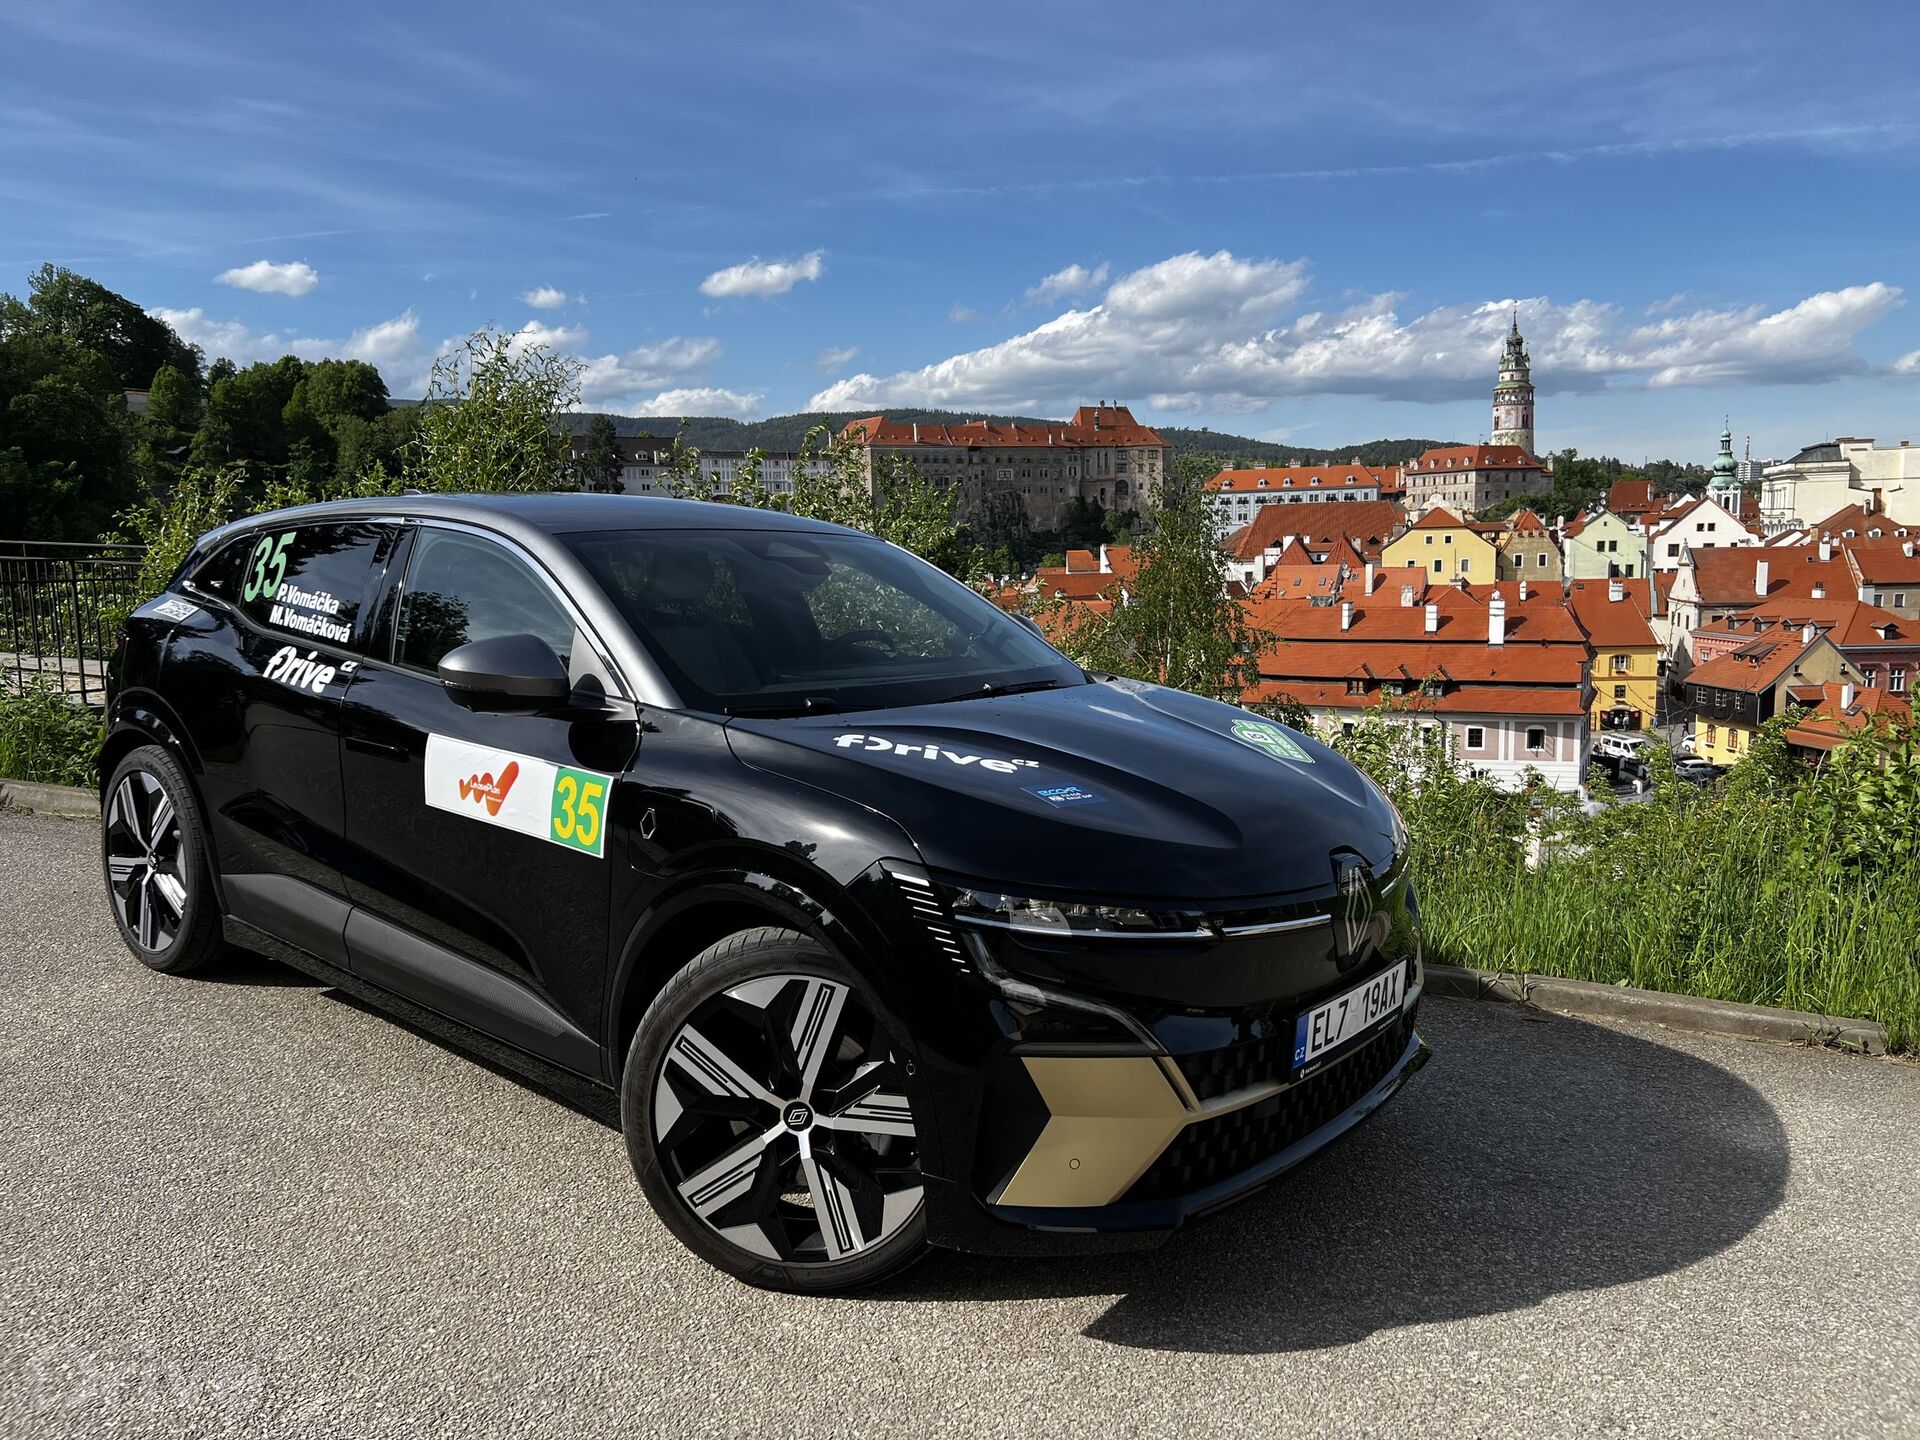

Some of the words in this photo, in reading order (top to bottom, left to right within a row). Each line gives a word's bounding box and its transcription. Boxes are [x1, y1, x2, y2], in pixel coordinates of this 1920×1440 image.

[244, 531, 297, 602] 35
[269, 605, 352, 643] M.Vomáčková
[276, 583, 340, 615] P.Vomáčka
[554, 775, 603, 846] 35
[1311, 999, 1350, 1053] EL7
[1362, 969, 1399, 1024] 19AX
[1294, 1046, 1305, 1061] CZ
